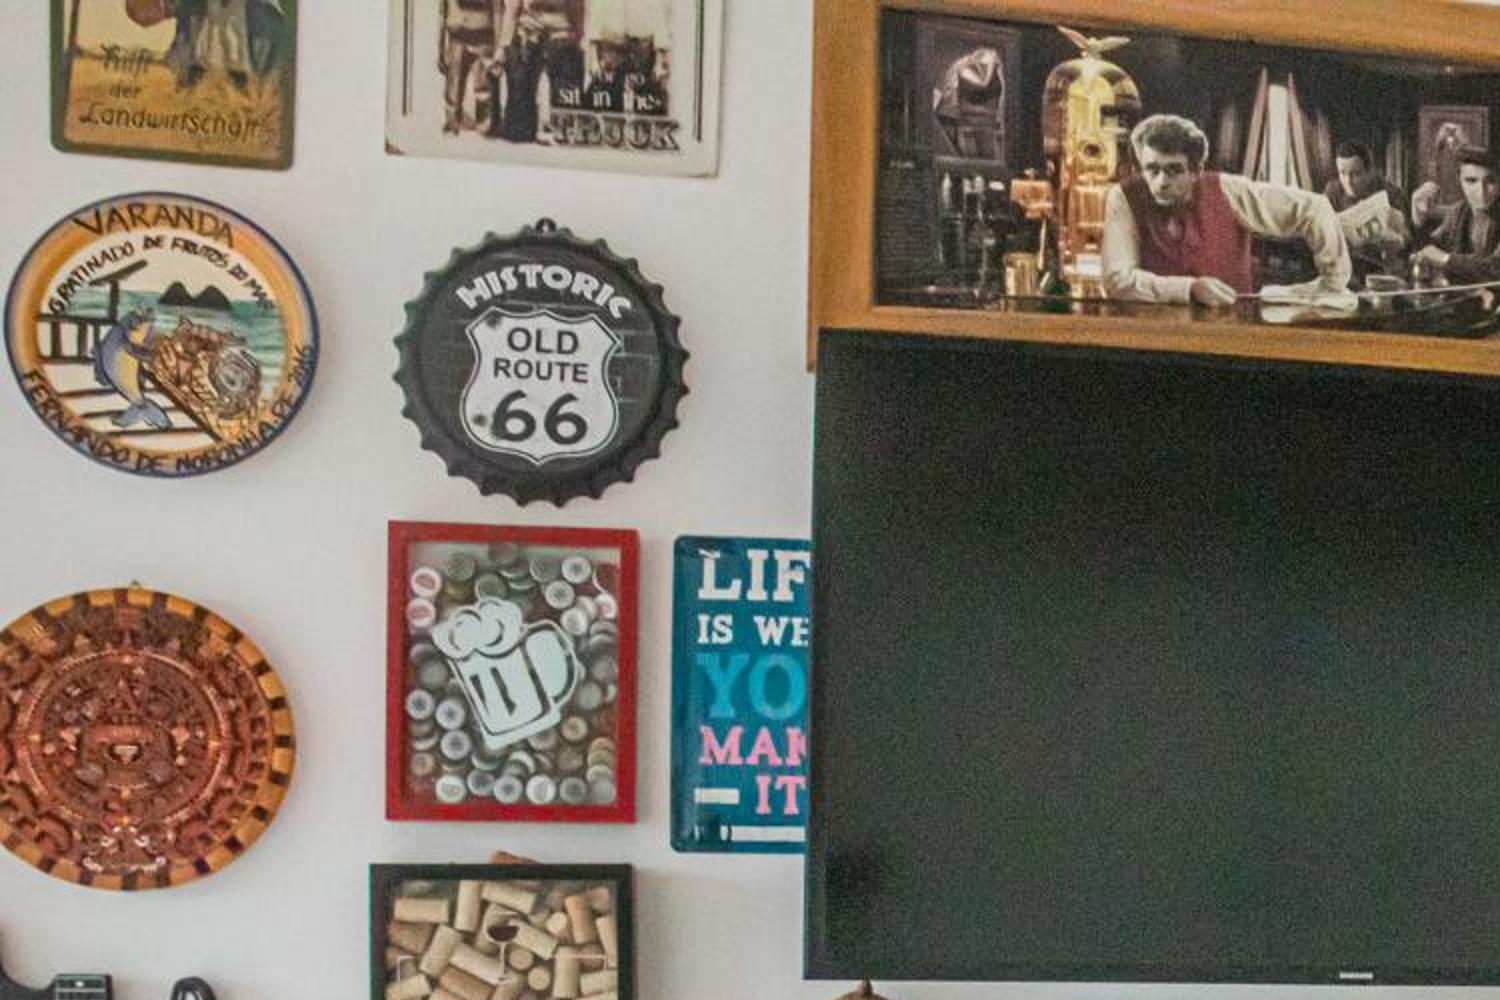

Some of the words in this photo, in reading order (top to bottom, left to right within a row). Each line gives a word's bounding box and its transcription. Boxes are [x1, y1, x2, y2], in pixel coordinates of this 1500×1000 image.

[110, 86, 139, 98] der
[559, 87, 580, 105] sit
[593, 86, 612, 107] in
[545, 111, 681, 151] TRUCK
[72, 203, 234, 248] VARANDA
[47, 240, 135, 314] GRATINADO
[142, 235, 164, 250] DE
[171, 237, 229, 268] FRUTOS
[455, 264, 632, 319] HISTORIC
[507, 327, 579, 355] OLD
[493, 358, 589, 384] ROUTE
[23, 367, 130, 463] FERNANDO
[136, 453, 169, 471] DE
[491, 390, 588, 445] 66
[698, 548, 811, 601] LIF
[697, 614, 733, 644] IS
[697, 653, 806, 720] YO
[755, 775, 806, 815] IT
